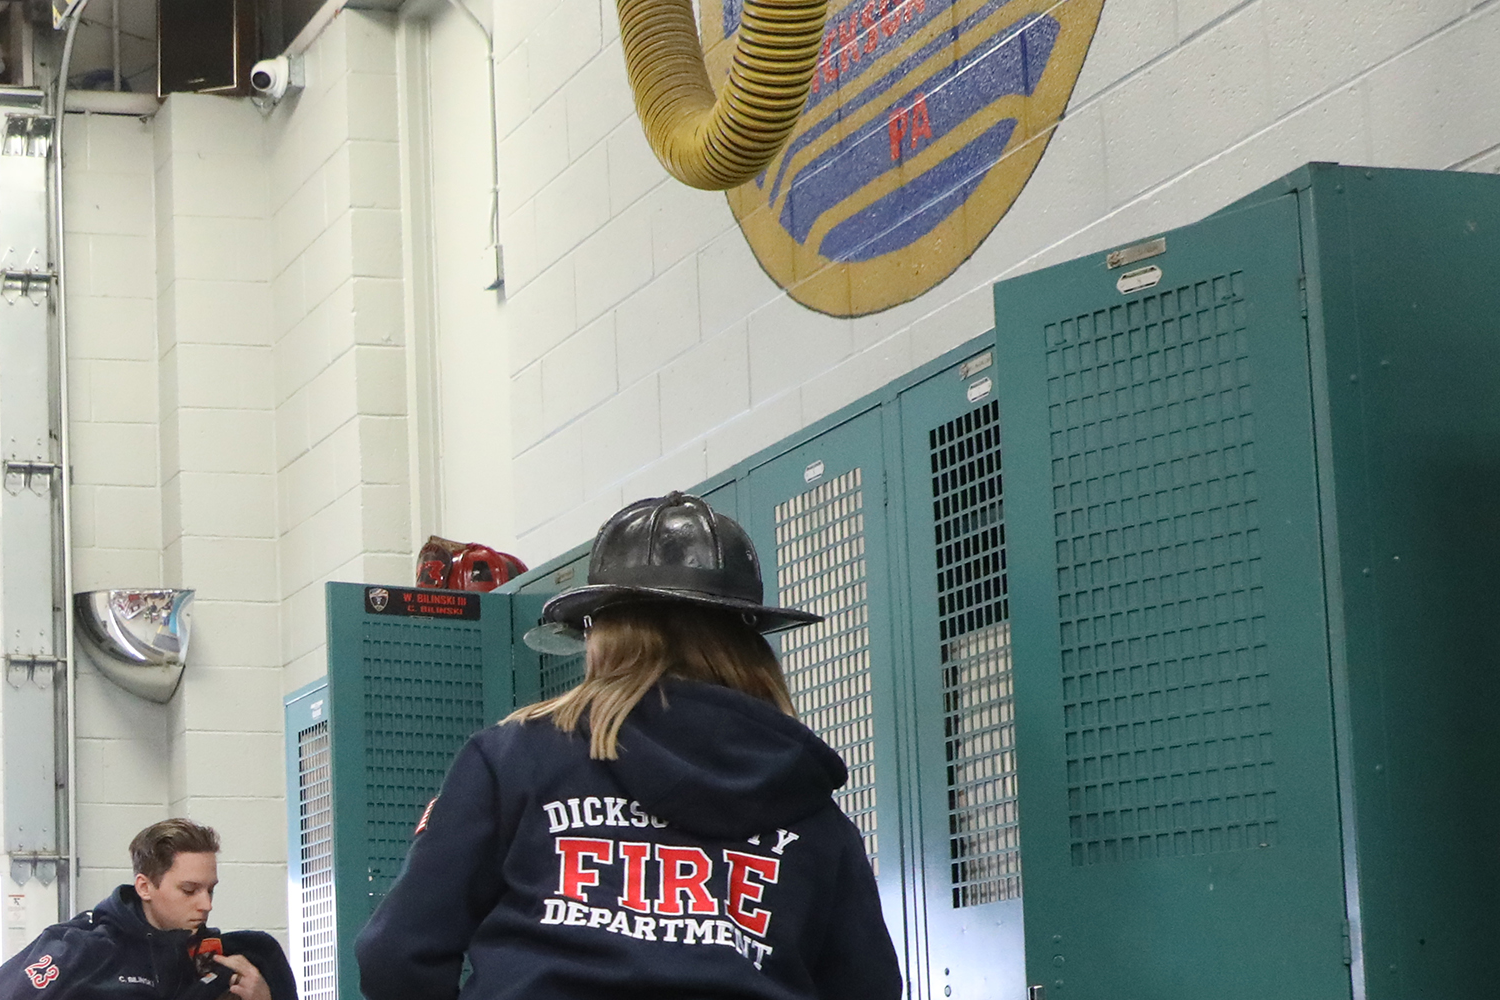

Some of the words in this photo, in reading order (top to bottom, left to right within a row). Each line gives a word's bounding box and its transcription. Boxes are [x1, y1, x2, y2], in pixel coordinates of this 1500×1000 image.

[888, 92, 932, 161] PA
[417, 594, 456, 605] BILINSKI
[554, 836, 780, 938] FIRE
[540, 899, 773, 971] DEPARTMENT
[24, 954, 60, 989] 23
